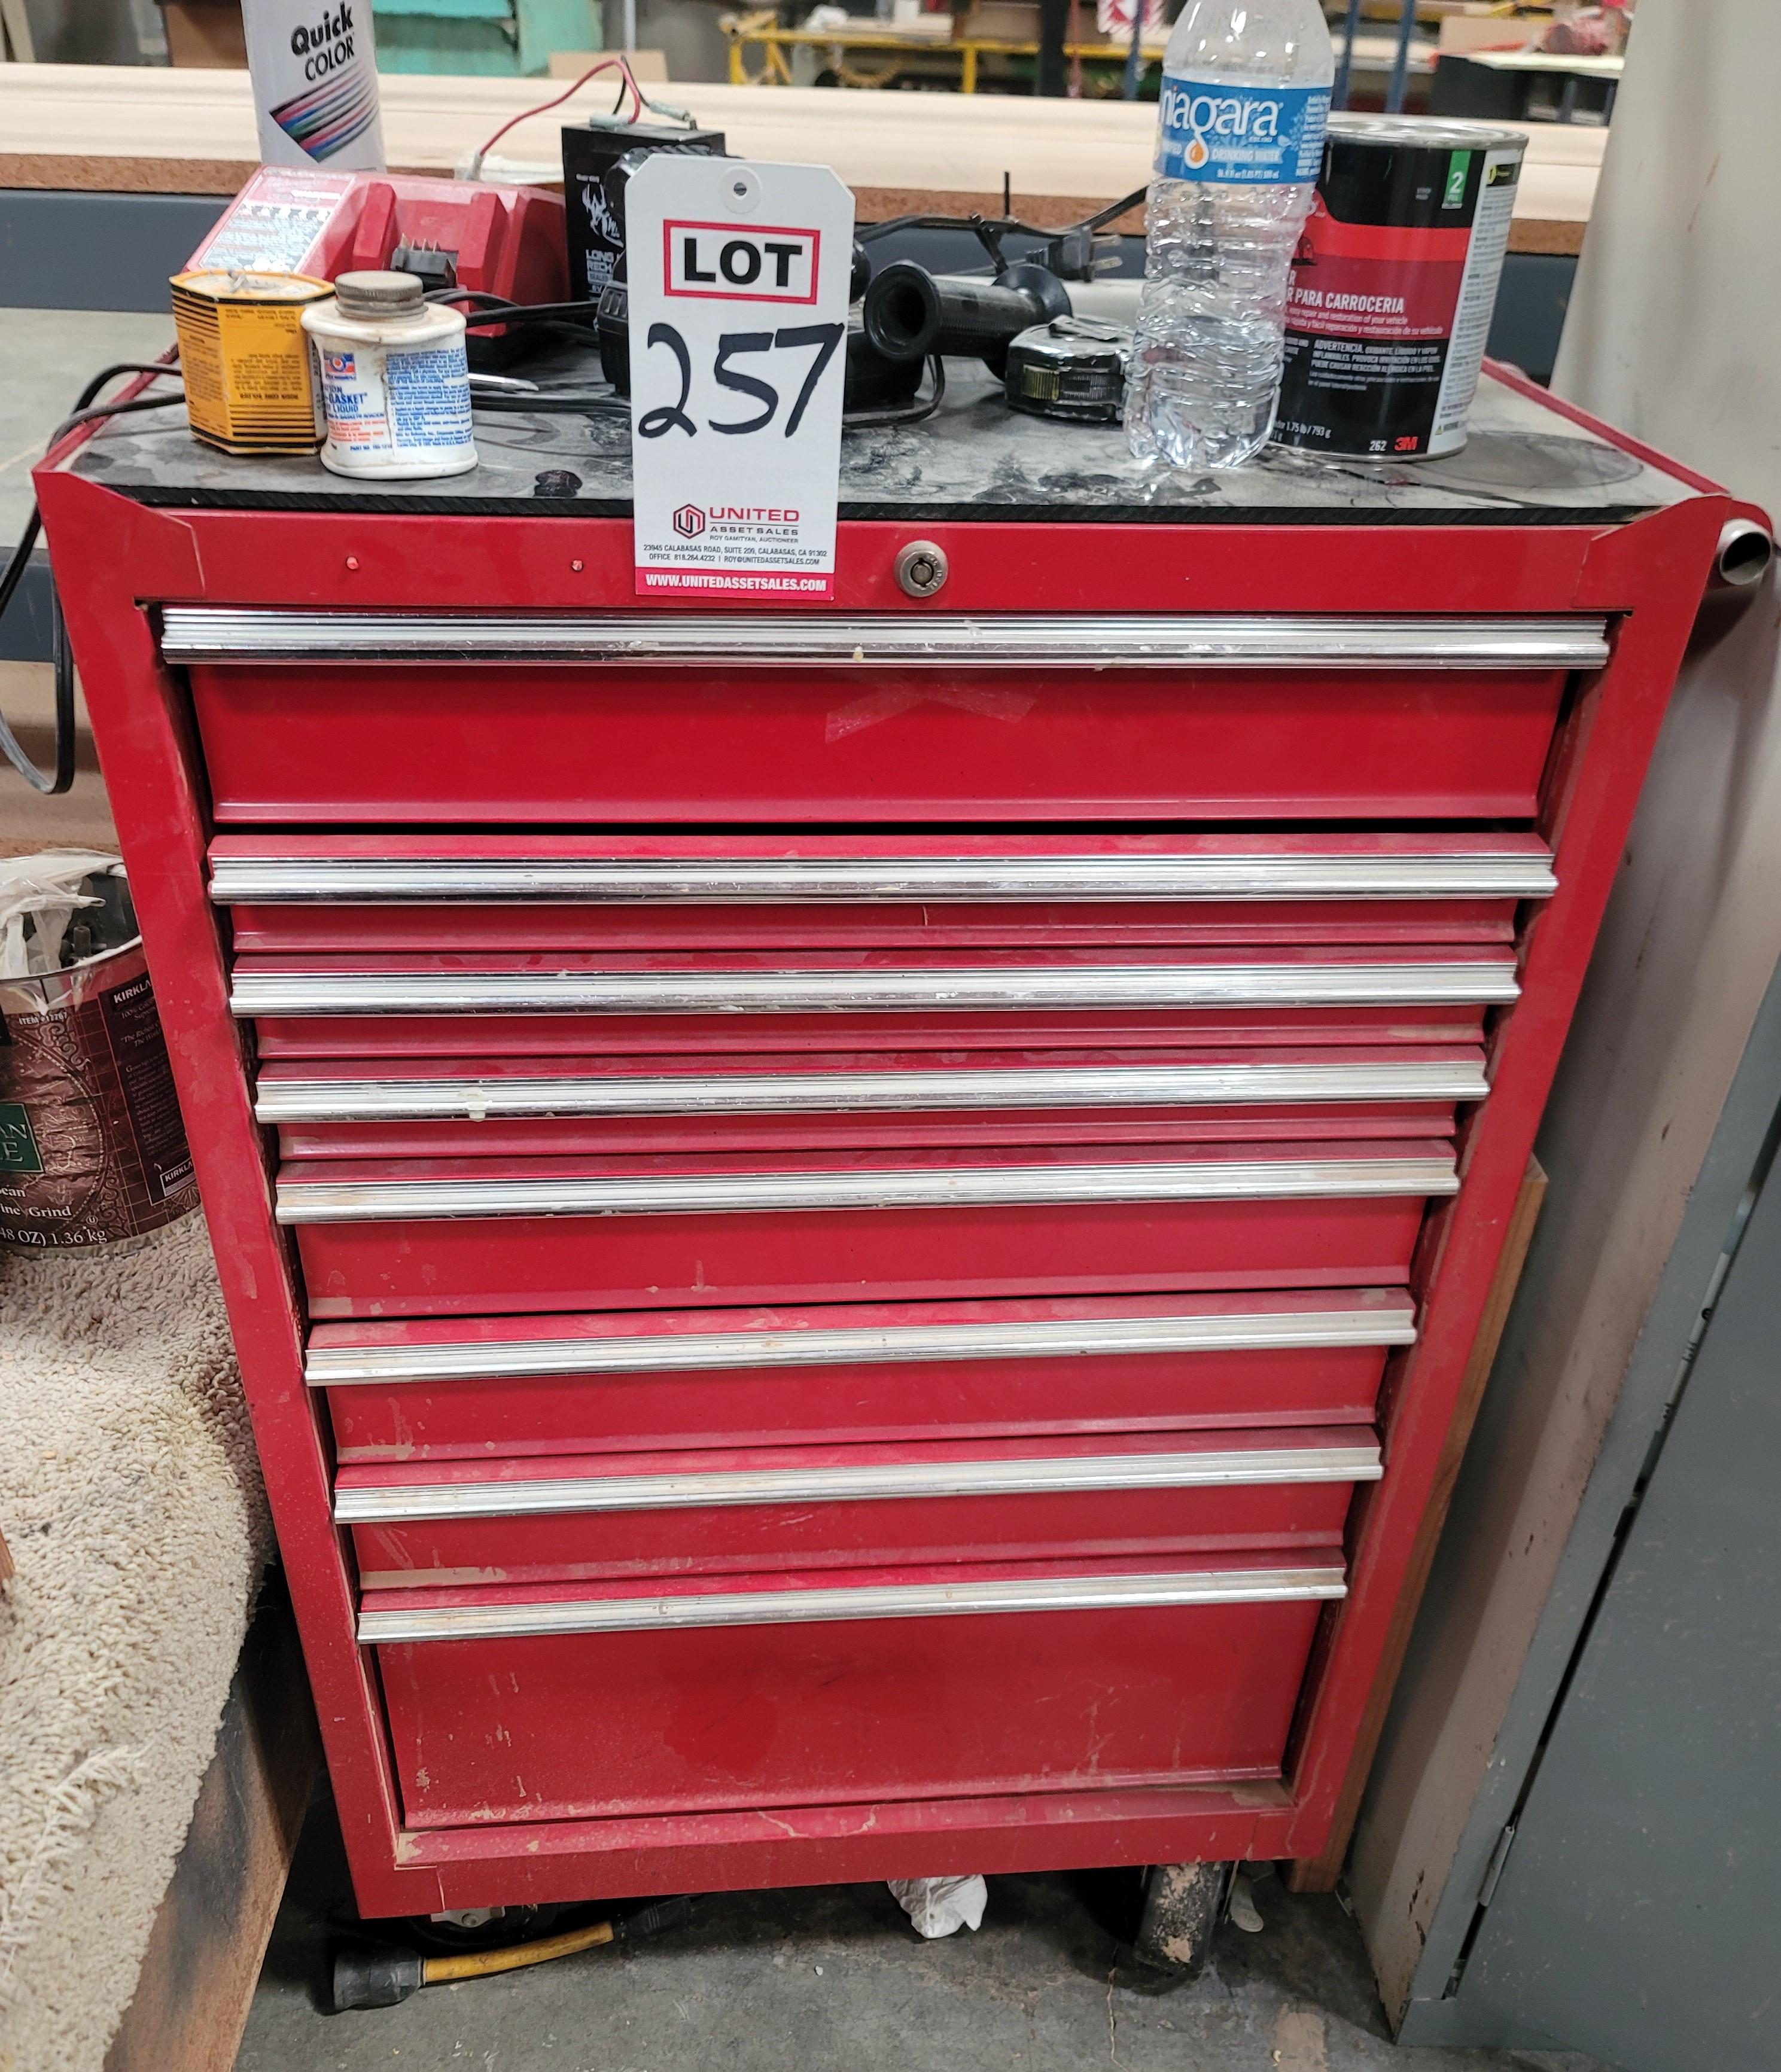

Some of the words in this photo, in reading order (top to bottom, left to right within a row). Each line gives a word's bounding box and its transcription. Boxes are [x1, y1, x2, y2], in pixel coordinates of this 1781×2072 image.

[291, 1, 354, 56] Quick
[305, 35, 354, 81] COLOR
[1161, 86, 1278, 169] niagara
[1450, 171, 1465, 194] 2
[684, 237, 802, 287] LOT
[1296, 288, 1322, 307] PARA
[1325, 292, 1405, 313] CARROCERIA
[638, 322, 845, 438] 257
[1369, 440, 1387, 452] 262
[1394, 437, 1418, 451] 3M
[710, 507, 799, 522] UNITED
[704, 546, 723, 554] ROAD,
[759, 548, 797, 556] CALABASAS,
[724, 556, 820, 565] ROY@UNITEDASSETSALES.COM
[646, 573, 827, 592] WWW.UNITEDASSETSALES.COM
[19, 1015, 39, 1025] ITEM
[0, 1203, 21, 1215] ine
[29, 1206, 72, 1217] Grind
[18, 1230, 47, 1247] OZ)
[50, 1230, 84, 1245] 1.36
[86, 1228, 108, 1244] kg
